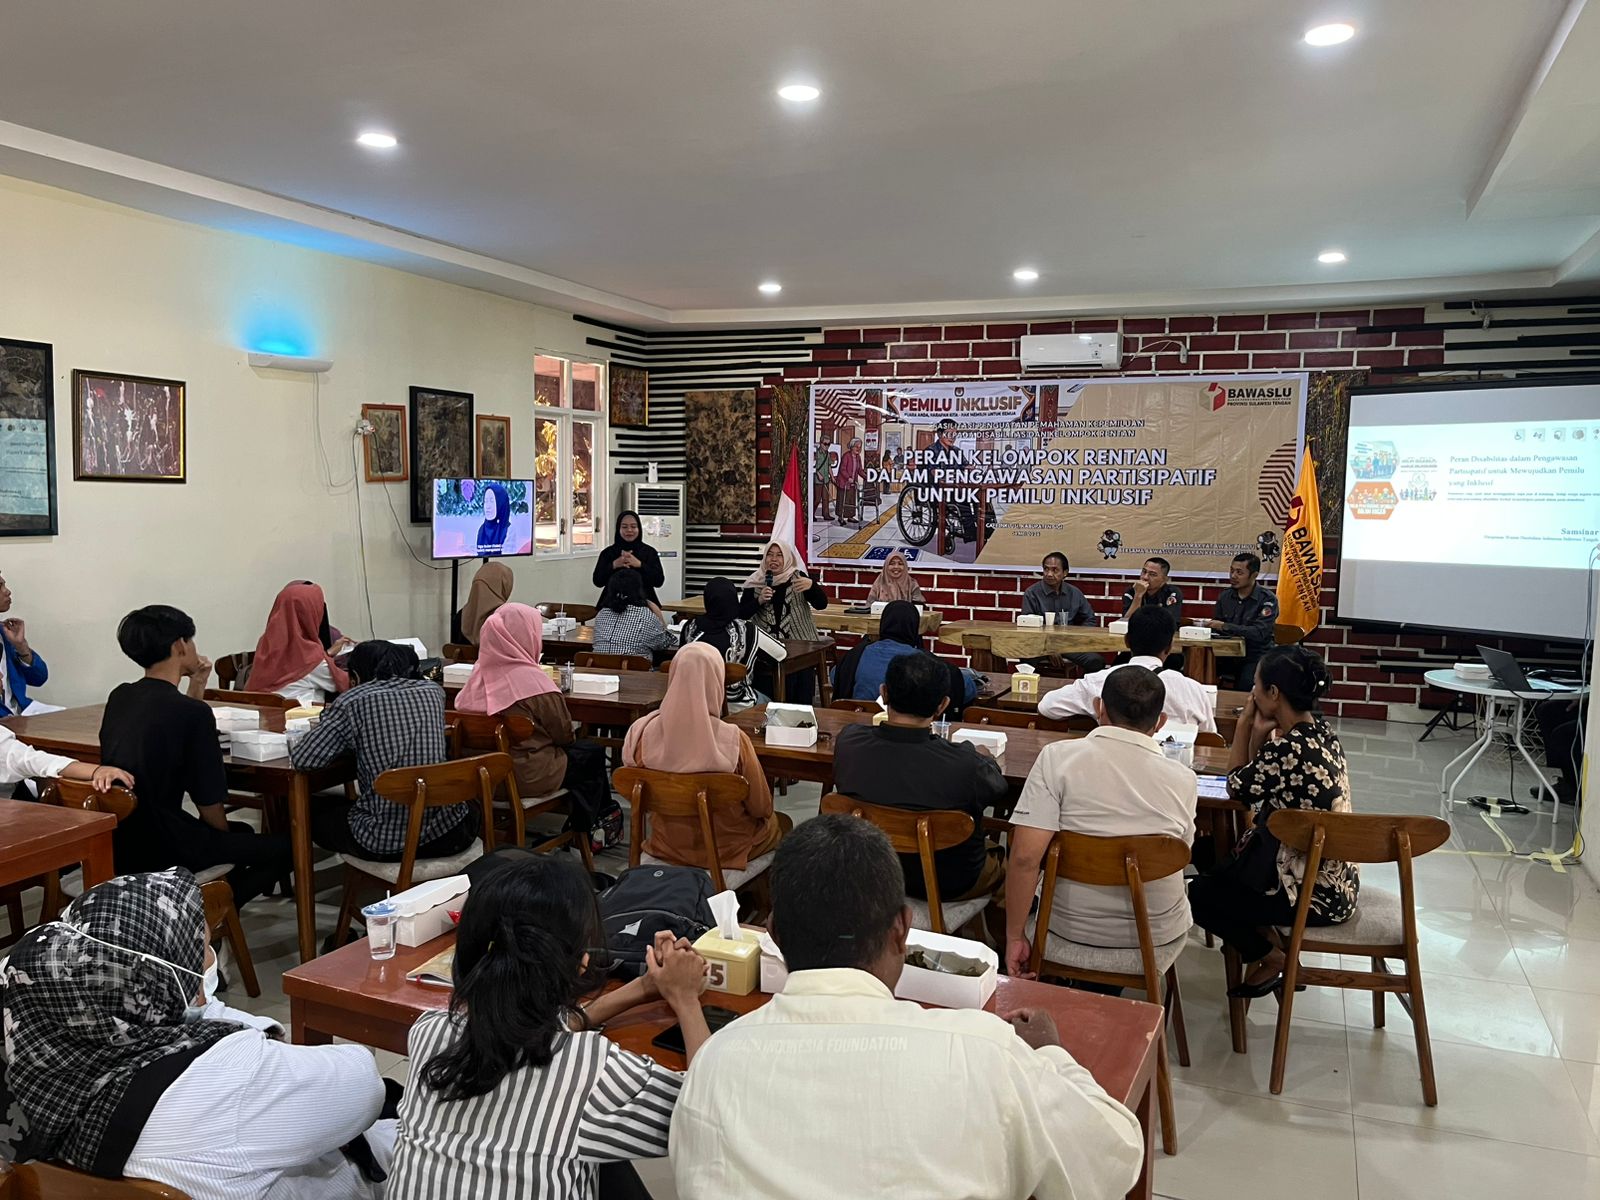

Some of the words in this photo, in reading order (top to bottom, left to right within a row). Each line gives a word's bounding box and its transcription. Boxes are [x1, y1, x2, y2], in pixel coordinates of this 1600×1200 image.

[1228, 388, 1292, 398] BAWASLU
[900, 398, 952, 412] PEMILU
[956, 396, 1022, 411] INKLUSIF
[976, 422, 1027, 430] PENGUATAN
[1030, 420, 1086, 429] PEMAHAMAN
[1088, 420, 1145, 428] KEPEMILUAN
[942, 431, 976, 439] KEPADA
[976, 430, 1028, 438] DISABILITAS
[1028, 430, 1048, 438] DAN
[1049, 430, 1098, 438] KELOMPOK
[903, 450, 962, 465] PERAN
[968, 449, 1078, 465] KELOMPOK
[1084, 449, 1166, 465] RENTAN
[1533, 454, 1578, 463] Pengawasan
[866, 468, 928, 484] DALAM
[934, 468, 1073, 485] PENGAWASAN
[1079, 469, 1216, 486] PARTISIPATIF
[1450, 468, 1486, 476] Partisipatif
[1510, 467, 1557, 476] Mewujudkan
[1559, 466, 1585, 474] Pemilu
[918, 488, 980, 503] UNTUK
[986, 488, 1055, 504] PEMILU
[1060, 489, 1153, 505] INKLUSIF
[1561, 528, 1600, 536] Samsinar
[1295, 579, 1312, 612] TENGAH
[710, 963, 724, 986] 5
[826, 1036, 908, 1053] FOUNDATION
